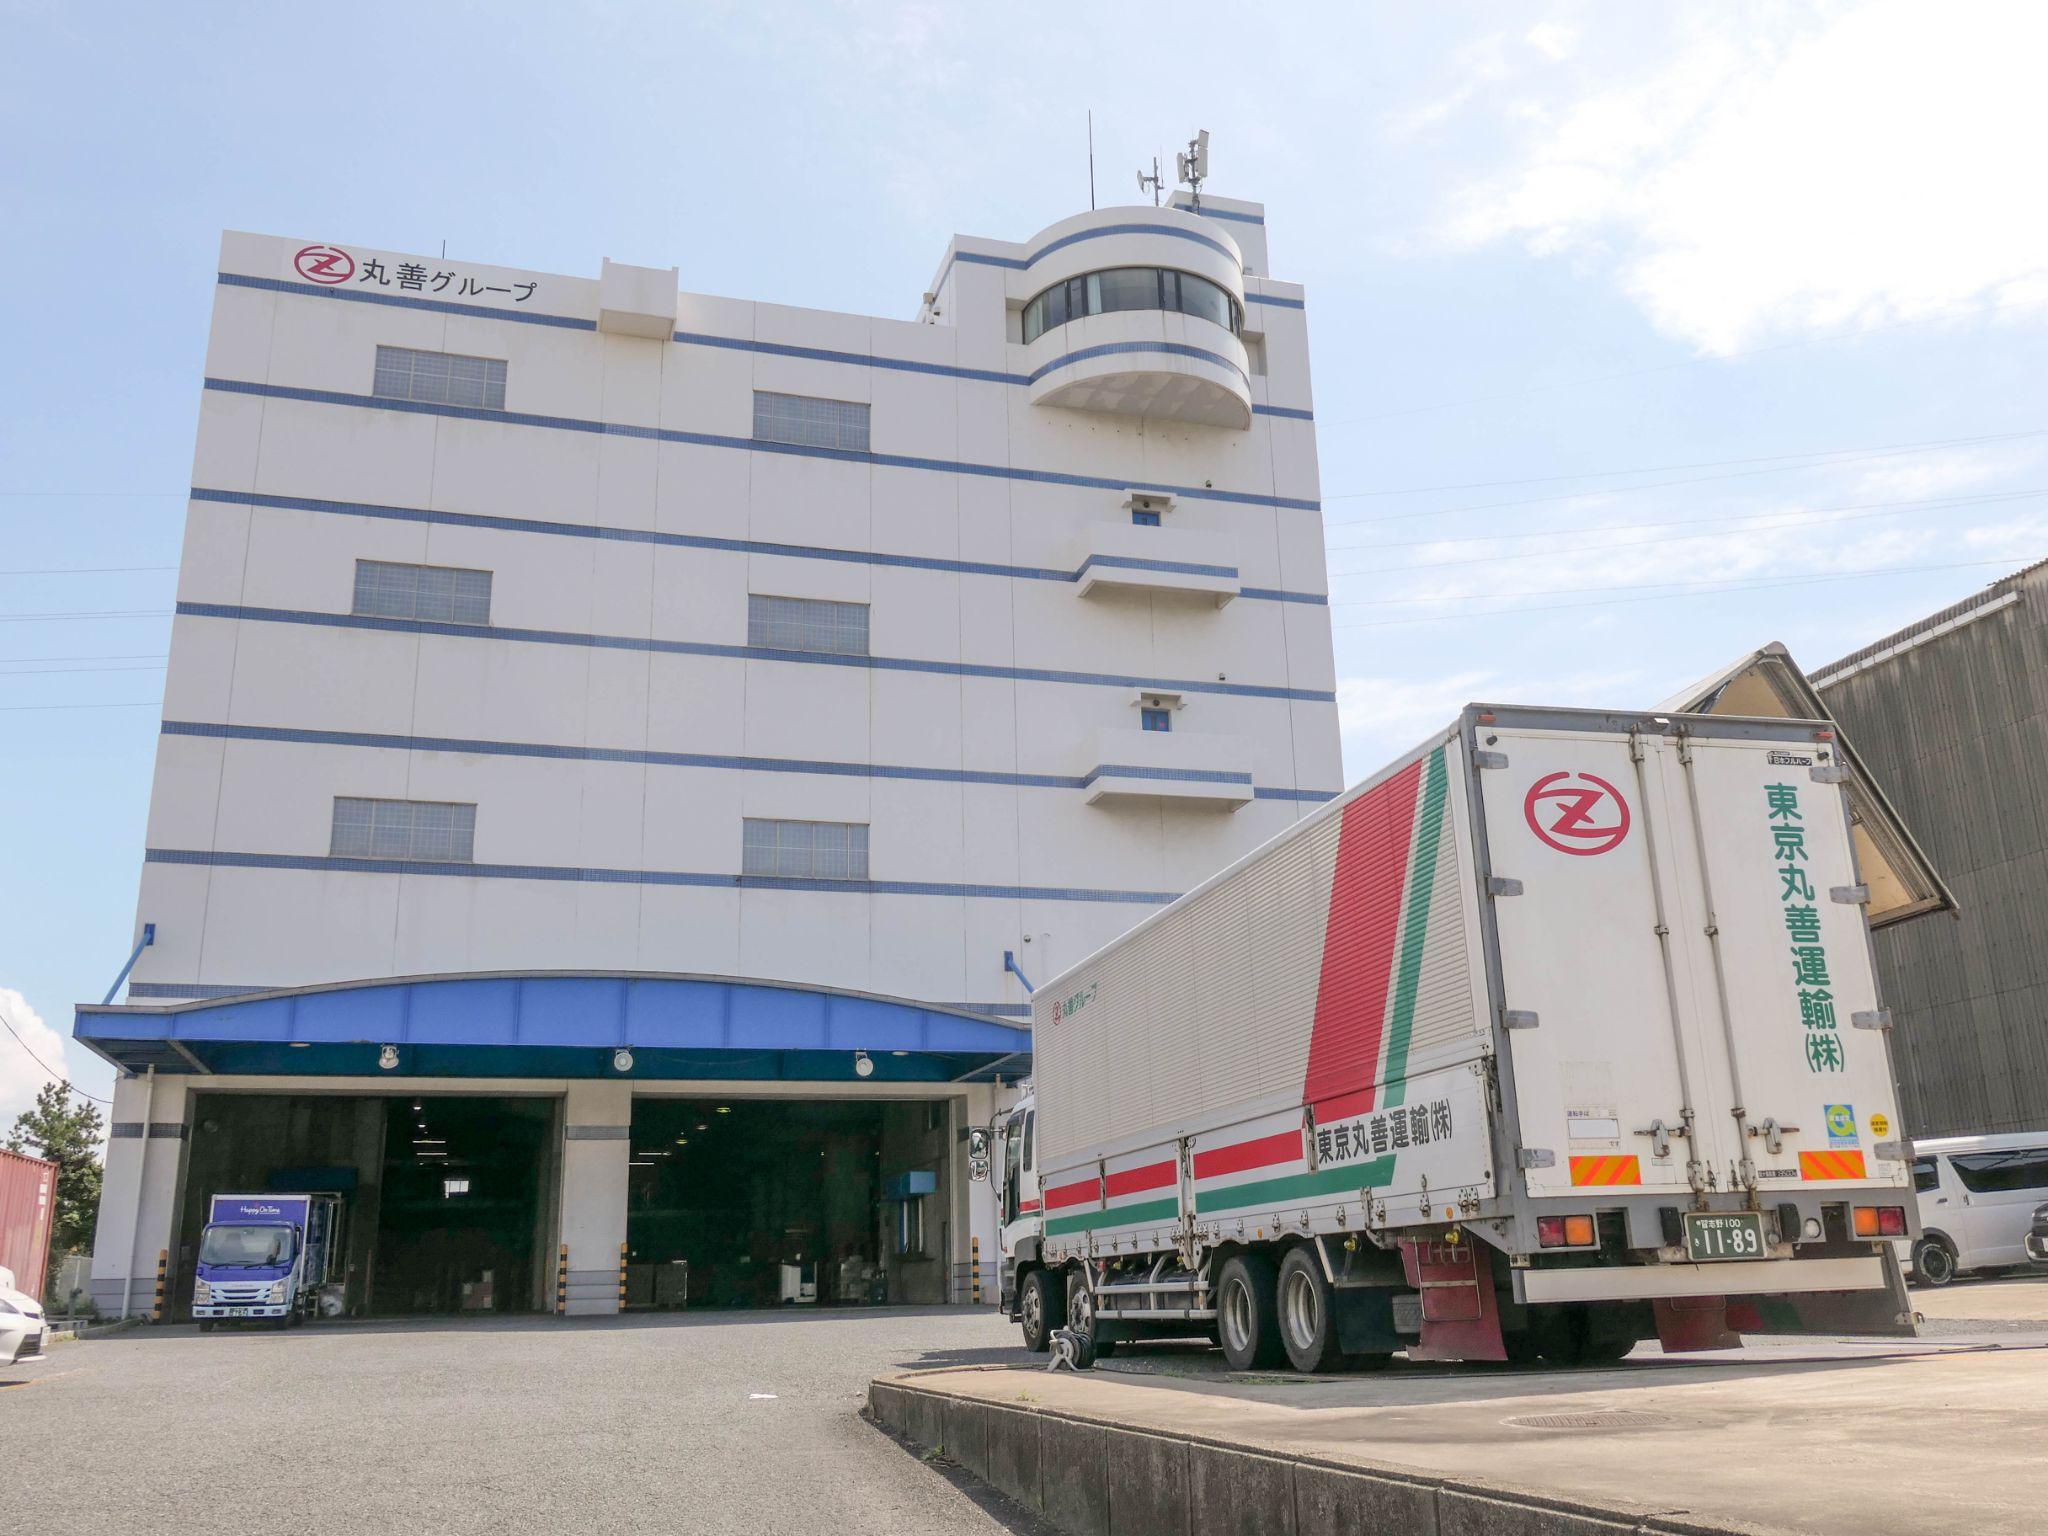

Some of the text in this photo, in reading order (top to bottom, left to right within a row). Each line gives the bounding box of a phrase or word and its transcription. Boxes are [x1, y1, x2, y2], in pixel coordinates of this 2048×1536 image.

[359, 257, 538, 302] 丸善グループ
[1763, 781, 1844, 1073] 東京丸善運輸(株)
[1316, 1098, 1453, 1165] 東京丸善運輸(株)
[240, 1205, 259, 1215] Happy
[1703, 1228, 1758, 1254] 11-89
